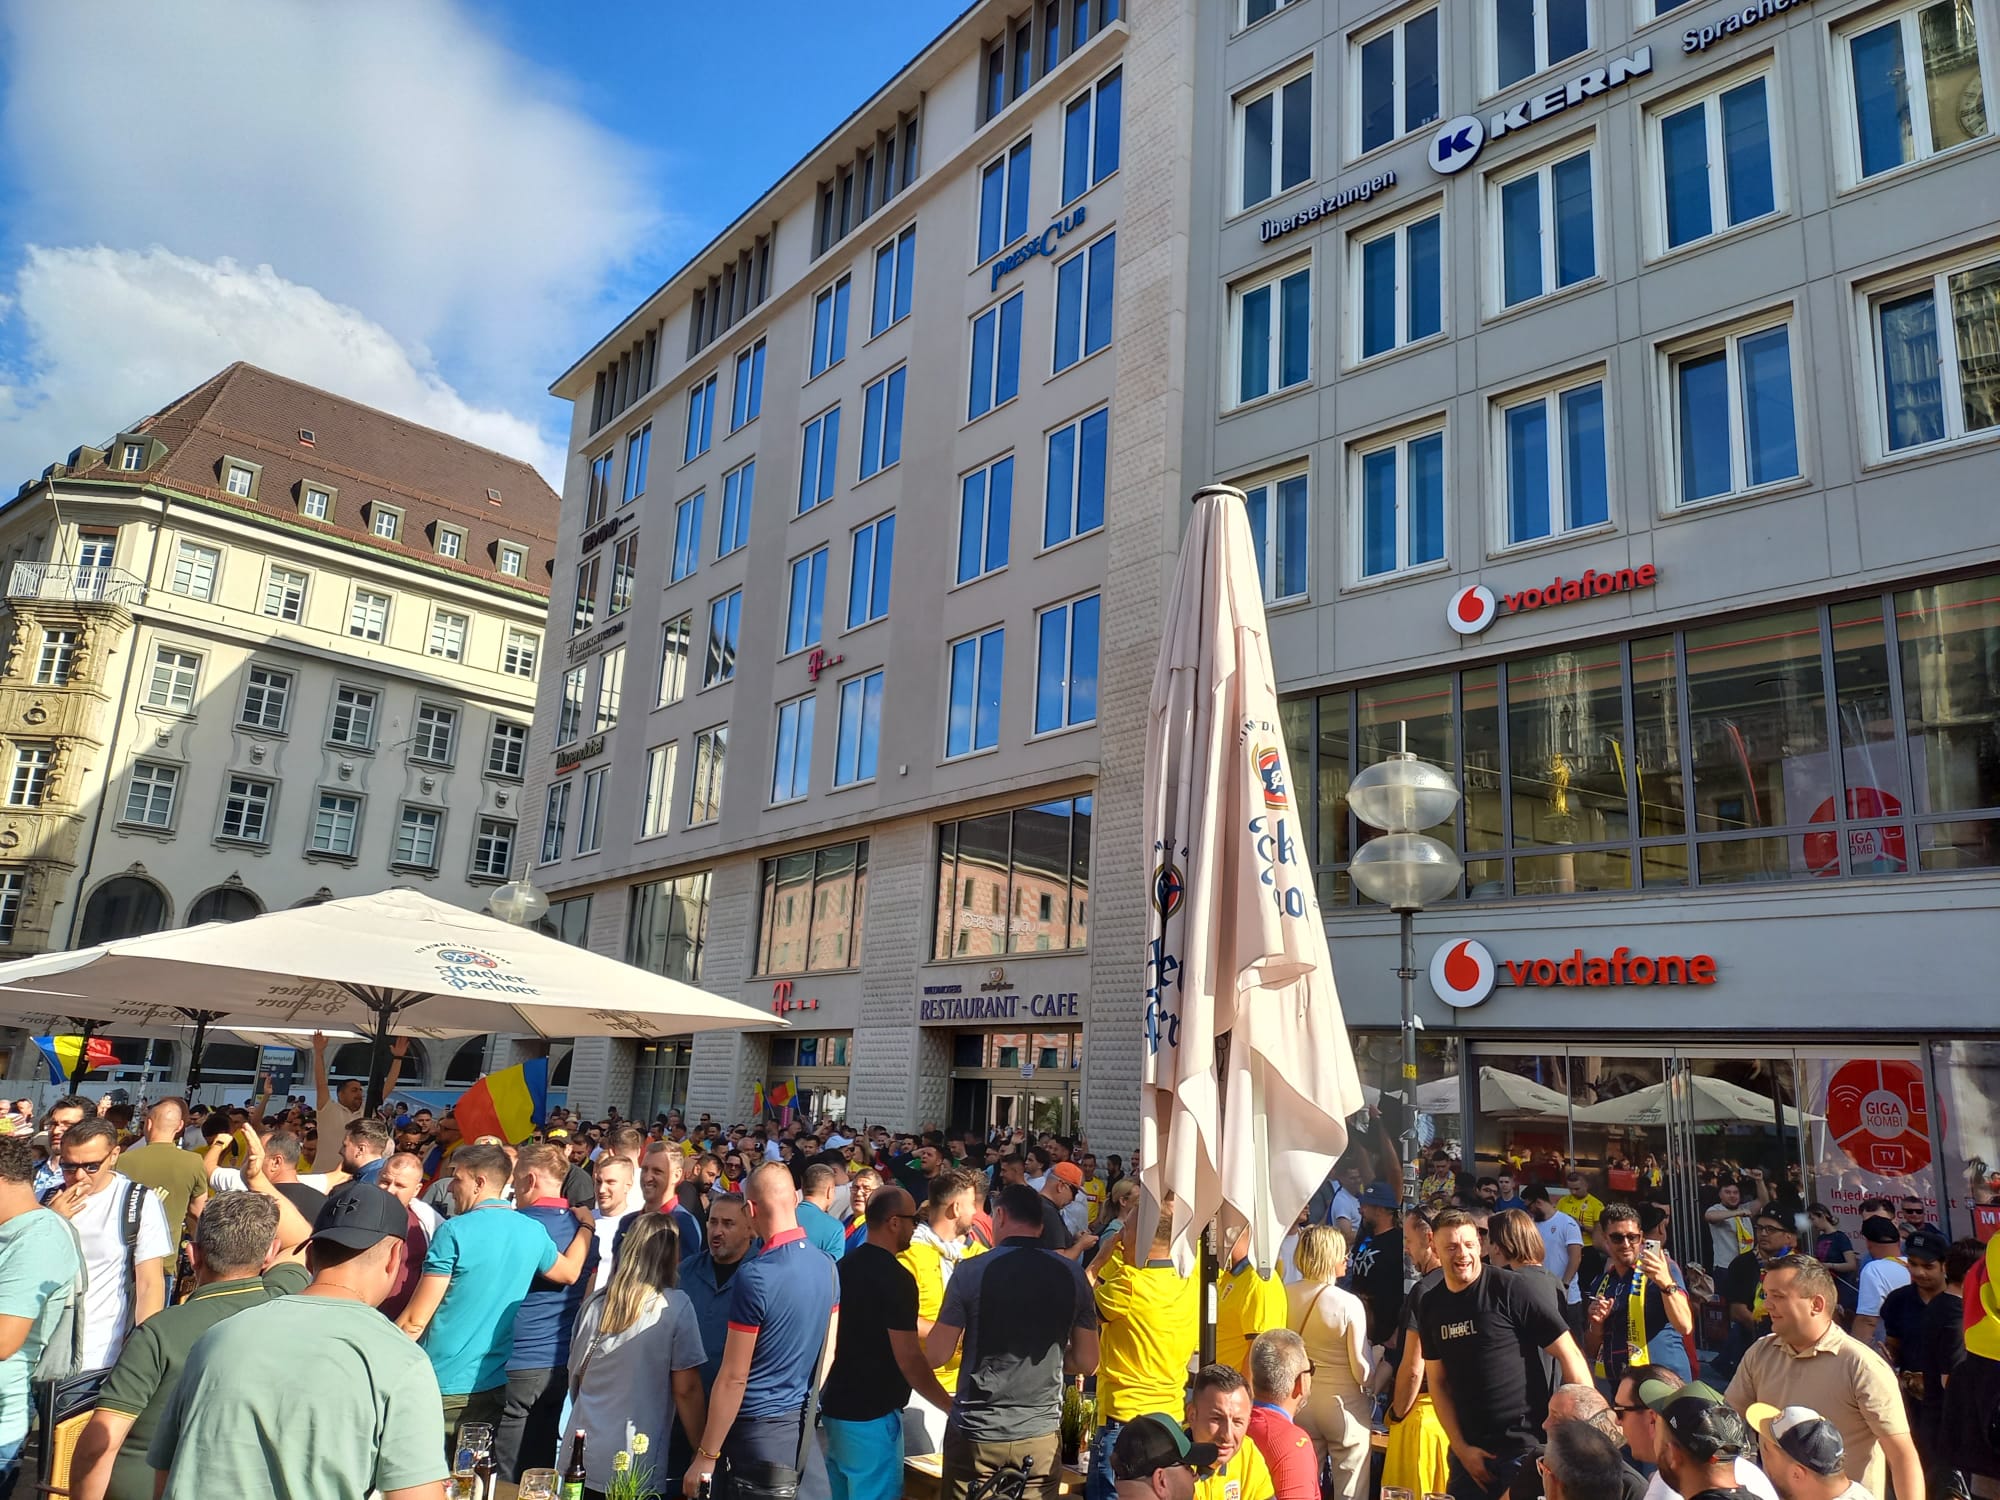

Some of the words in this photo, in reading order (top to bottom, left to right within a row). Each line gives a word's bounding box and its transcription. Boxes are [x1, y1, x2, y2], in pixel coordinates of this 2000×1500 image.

[1490, 46, 1653, 140] KERN
[1259, 169, 1396, 243] Übersetzungen
[1504, 563, 1656, 612] vodafone
[1850, 831, 1875, 845] IGA
[1850, 844, 1876, 857] OMBI
[1505, 946, 1718, 987] vodafone
[920, 996, 1019, 1020] RESTAURANT
[1030, 993, 1079, 1017] CAFE
[1866, 1102, 1901, 1115] GIGA
[1866, 1115, 1903, 1127] KOMBI
[1880, 1151, 1895, 1161] TV
[1831, 1189, 1842, 1199] In
[1441, 1320, 1478, 1340] DIESEL
